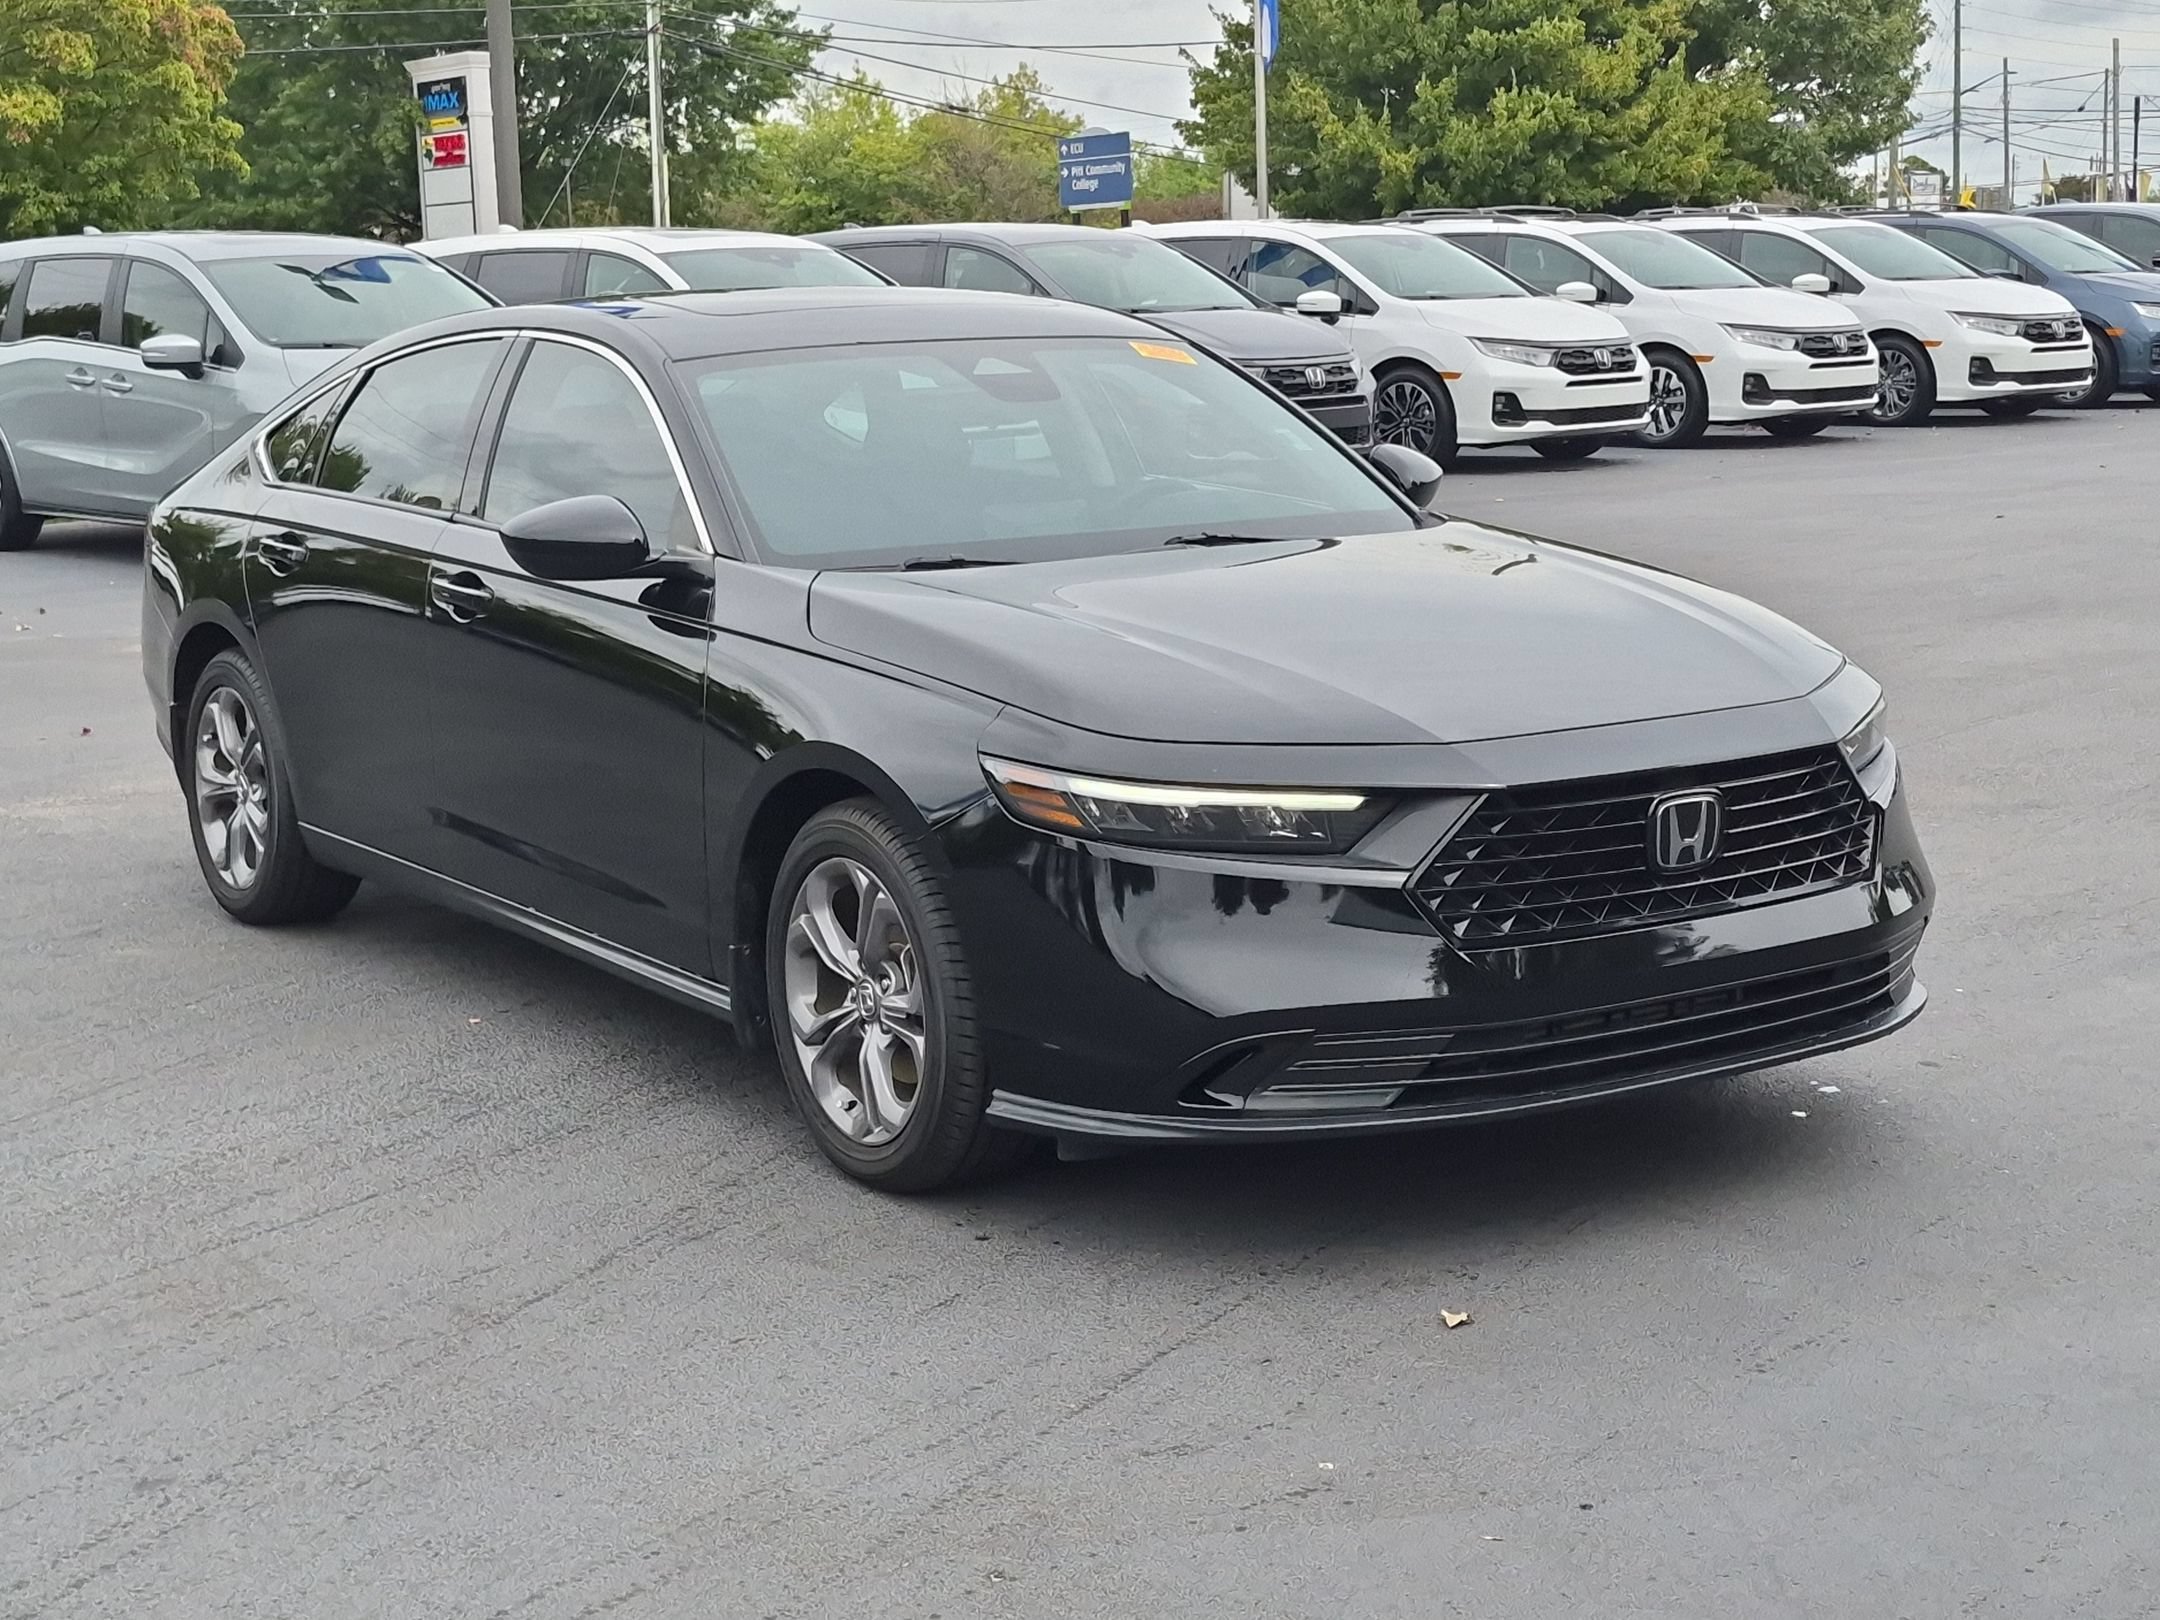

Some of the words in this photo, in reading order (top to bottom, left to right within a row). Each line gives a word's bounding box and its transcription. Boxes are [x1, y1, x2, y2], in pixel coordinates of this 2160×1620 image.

[423, 92, 459, 112] IMAX
[1070, 143, 1084, 154] ECU
[1085, 161, 1126, 176] Community
[1071, 178, 1099, 192] College
